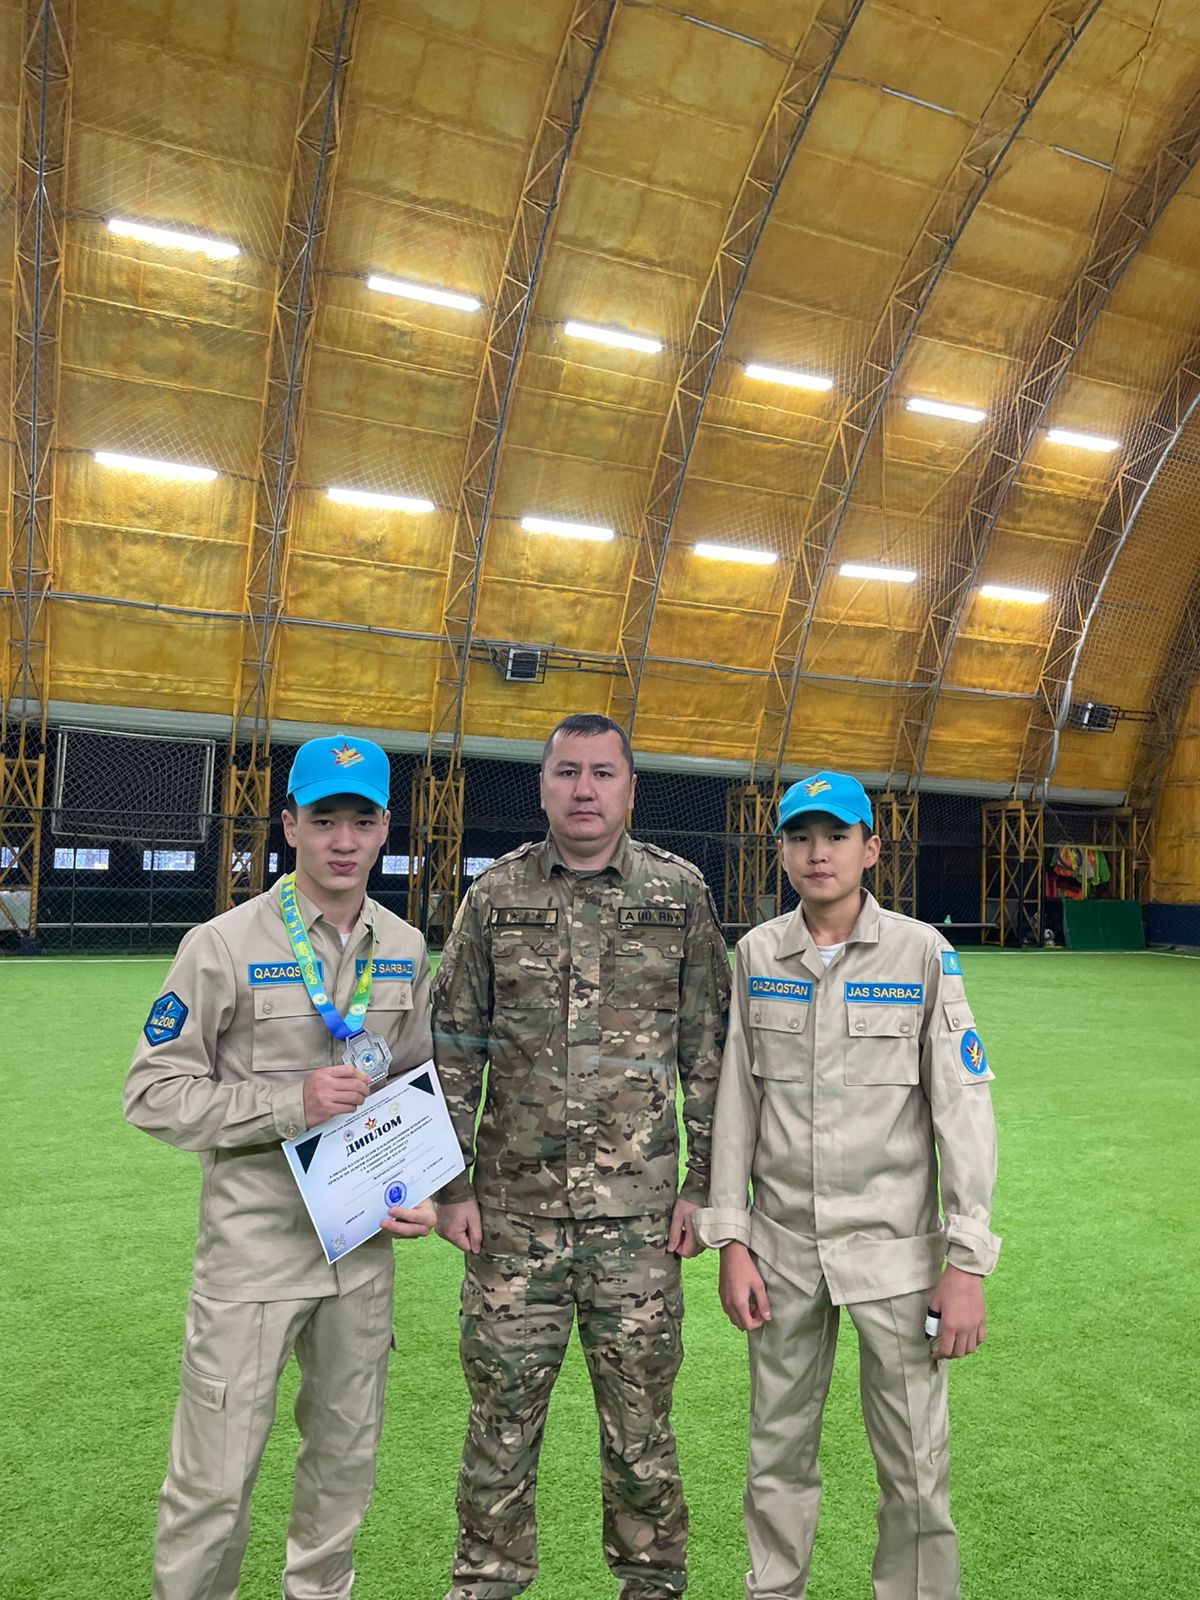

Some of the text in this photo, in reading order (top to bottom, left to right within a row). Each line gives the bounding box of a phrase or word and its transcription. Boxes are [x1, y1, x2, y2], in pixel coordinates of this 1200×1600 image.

[281, 881, 307, 944] ALMATY
[625, 911, 635, 921] A
[253, 966, 302, 980] QAZAQS
[358, 962, 413, 975] JS SARBAZ
[751, 980, 809, 997] QAZAQSTAN
[848, 986, 921, 999] JAS SARBAZ
[345, 1114, 402, 1158] ДИПЛОМ
